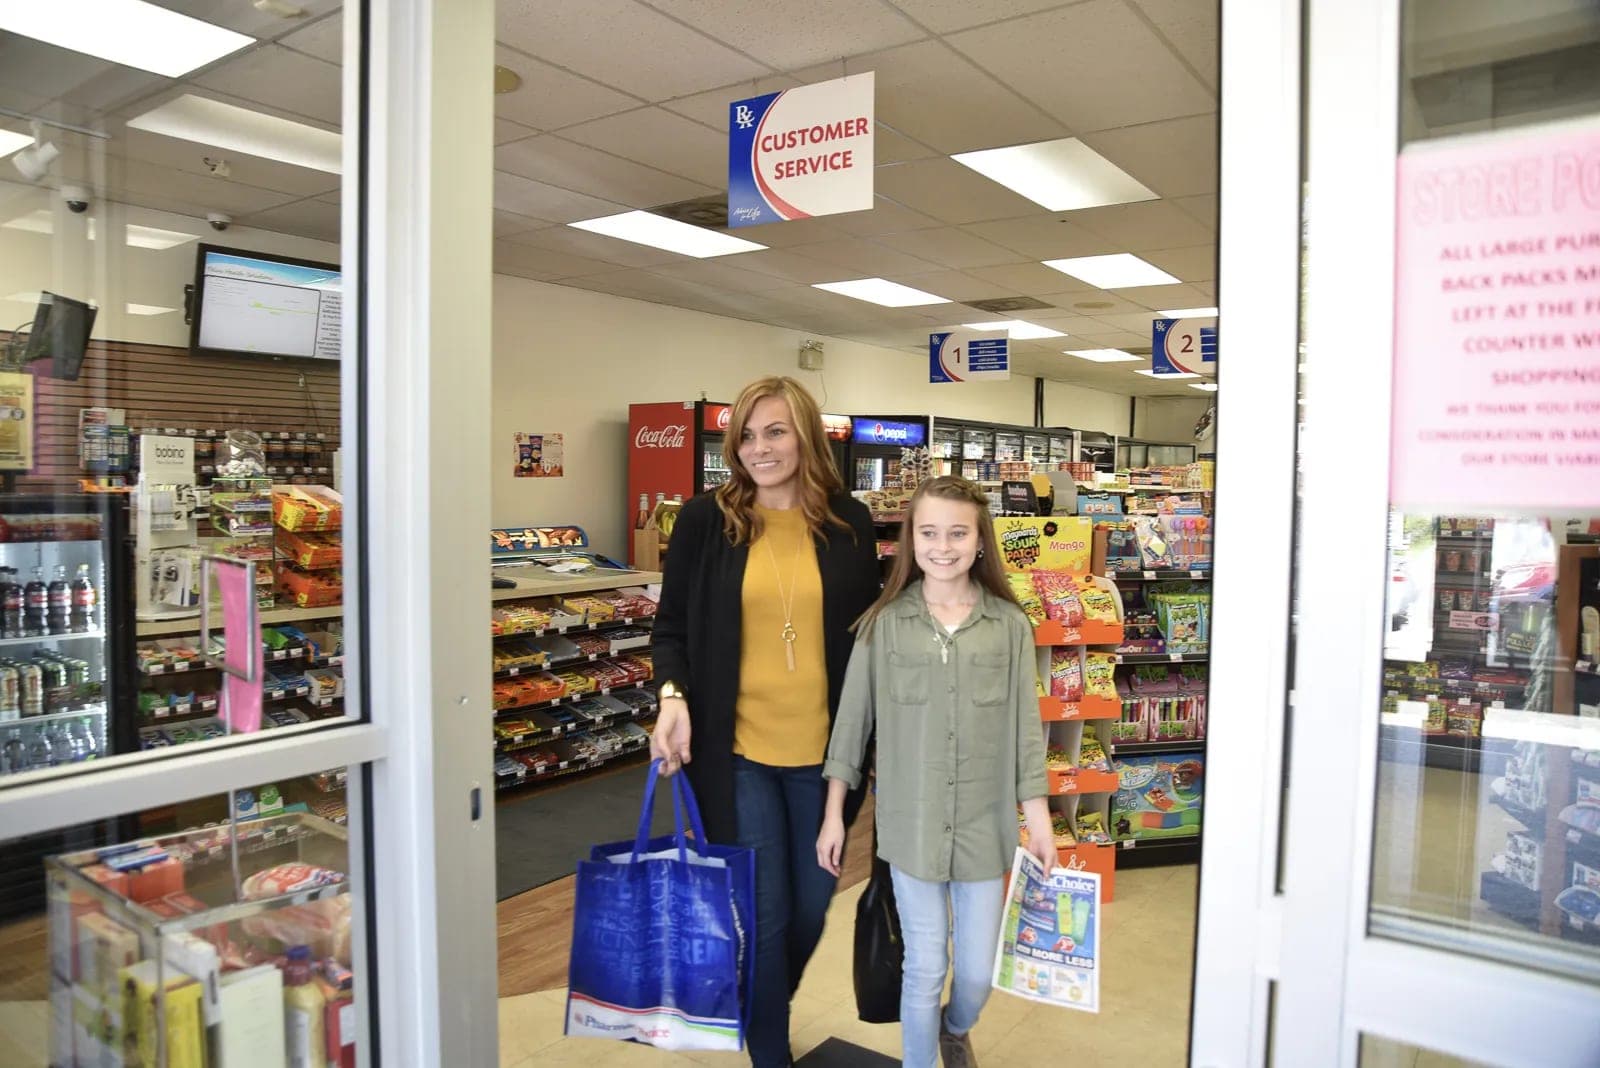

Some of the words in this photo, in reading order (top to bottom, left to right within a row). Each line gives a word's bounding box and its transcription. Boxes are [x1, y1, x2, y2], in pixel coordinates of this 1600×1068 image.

[761, 117, 869, 153] CUSTOMER
[774, 150, 853, 180] SERVICE
[1412, 157, 1543, 228] STORE
[1441, 245, 1471, 261] ALL
[1479, 237, 1545, 260] LARGE
[1441, 274, 1494, 292] BACK
[1501, 269, 1567, 287] PACKS
[1452, 304, 1496, 324] LEFT
[1505, 303, 1528, 319] AT
[1537, 301, 1575, 318] THE
[1181, 334, 1194, 353] 2
[1463, 333, 1564, 353] COUNTER
[952, 346, 961, 364] 1
[1447, 403, 1469, 415] WE
[1475, 402, 1528, 414] THANK
[1536, 400, 1569, 413] YOU
[884, 427, 908, 442] pepsi
[1417, 428, 1543, 442] CONSIDERATION
[1549, 429, 1566, 441] IN
[155, 444, 185, 458] bobino
[1461, 453, 1495, 465] OUR
[1501, 452, 1549, 465] STORE
[1006, 537, 1038, 550] SOUR
[1049, 540, 1085, 551] Mango
[1006, 547, 1040, 562] PATCH
